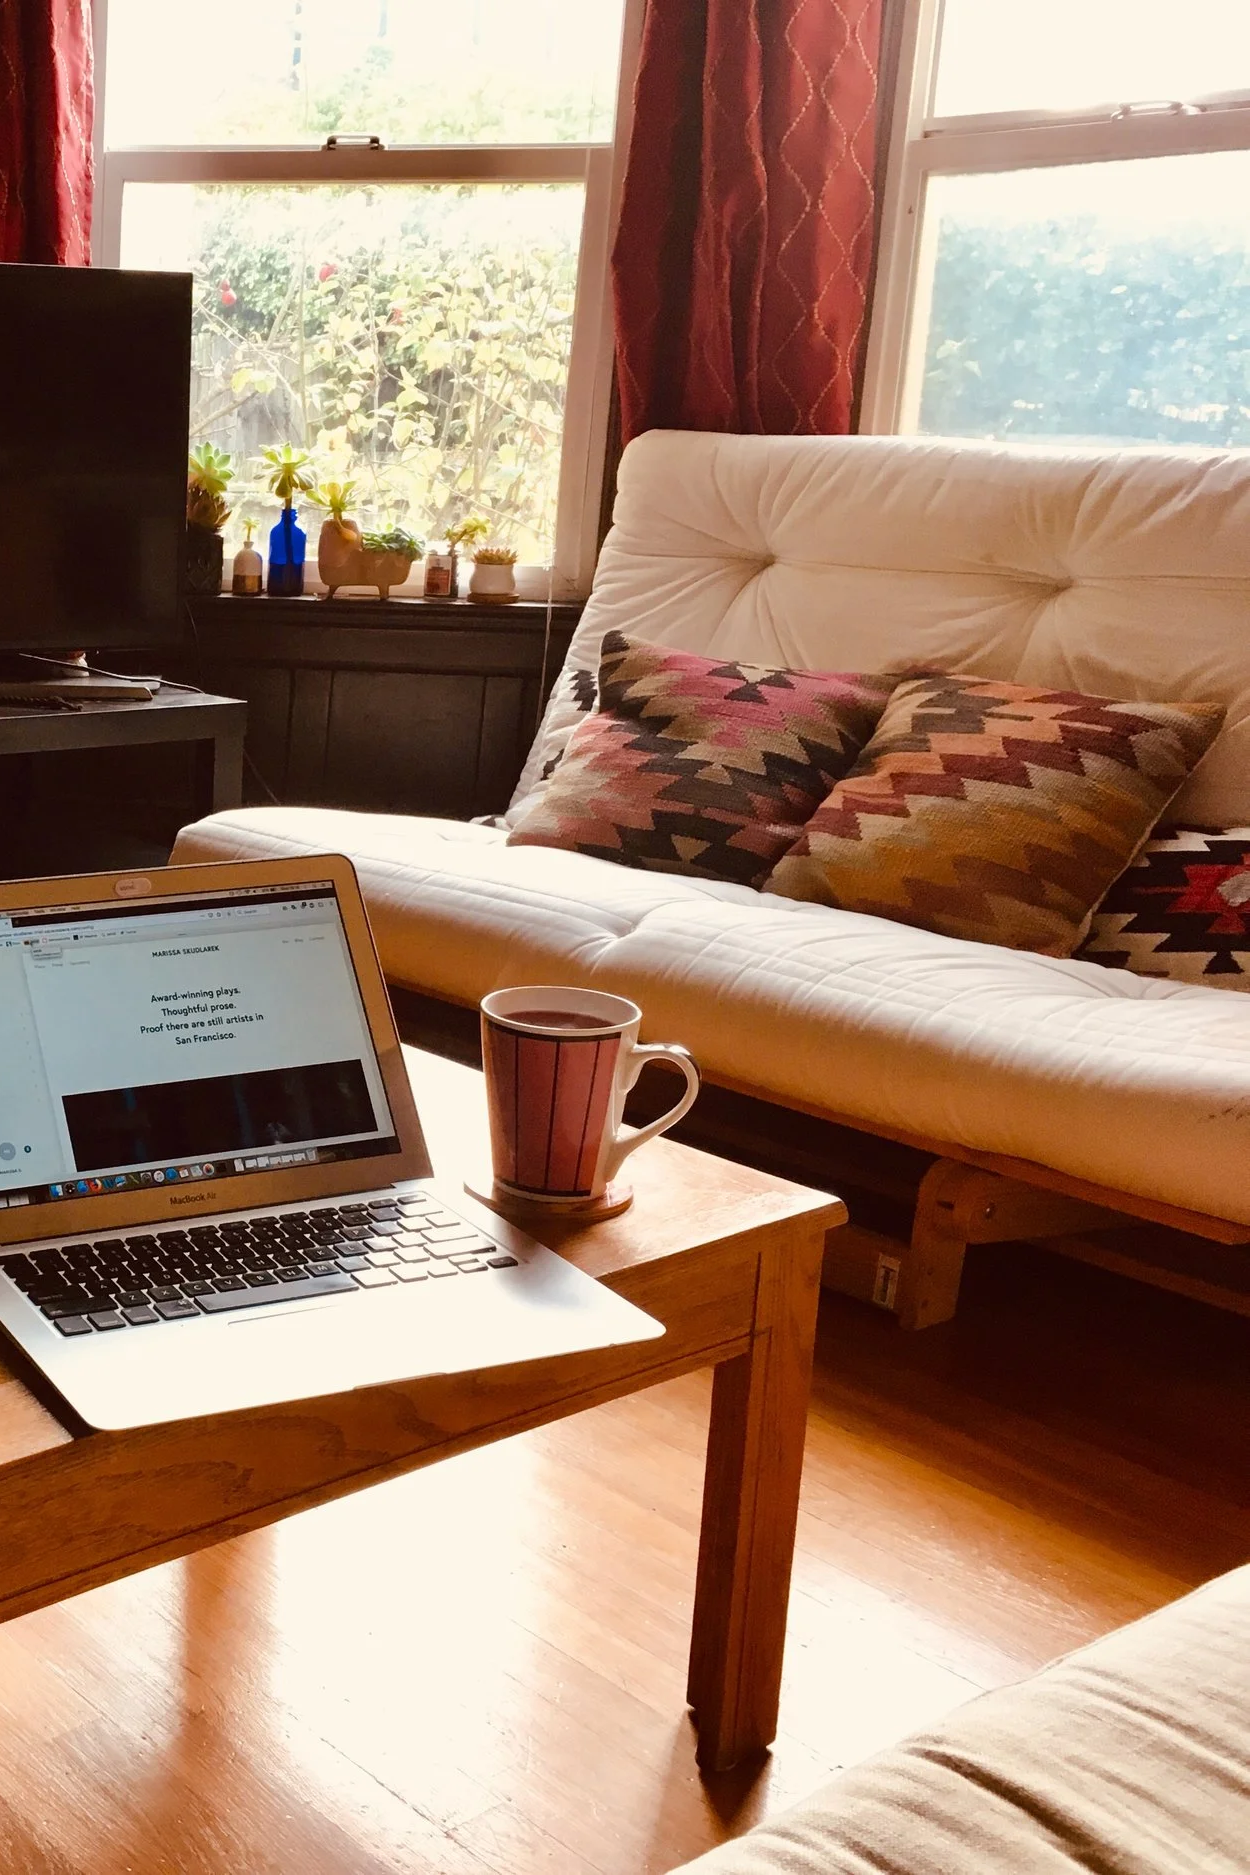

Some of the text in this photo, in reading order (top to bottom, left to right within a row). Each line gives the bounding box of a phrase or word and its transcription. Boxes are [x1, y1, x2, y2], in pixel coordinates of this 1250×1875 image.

[152, 944, 220, 958] MARISSA SKUDLAREK
[150, 986, 241, 1003] Award-winning plays.
[161, 1002, 237, 1017] Thoughtful prose.
[140, 1012, 264, 1034] Proof there are still artists in
[175, 1031, 237, 1045] San Francisco.
[170, 1191, 217, 1206] MacBook Air
